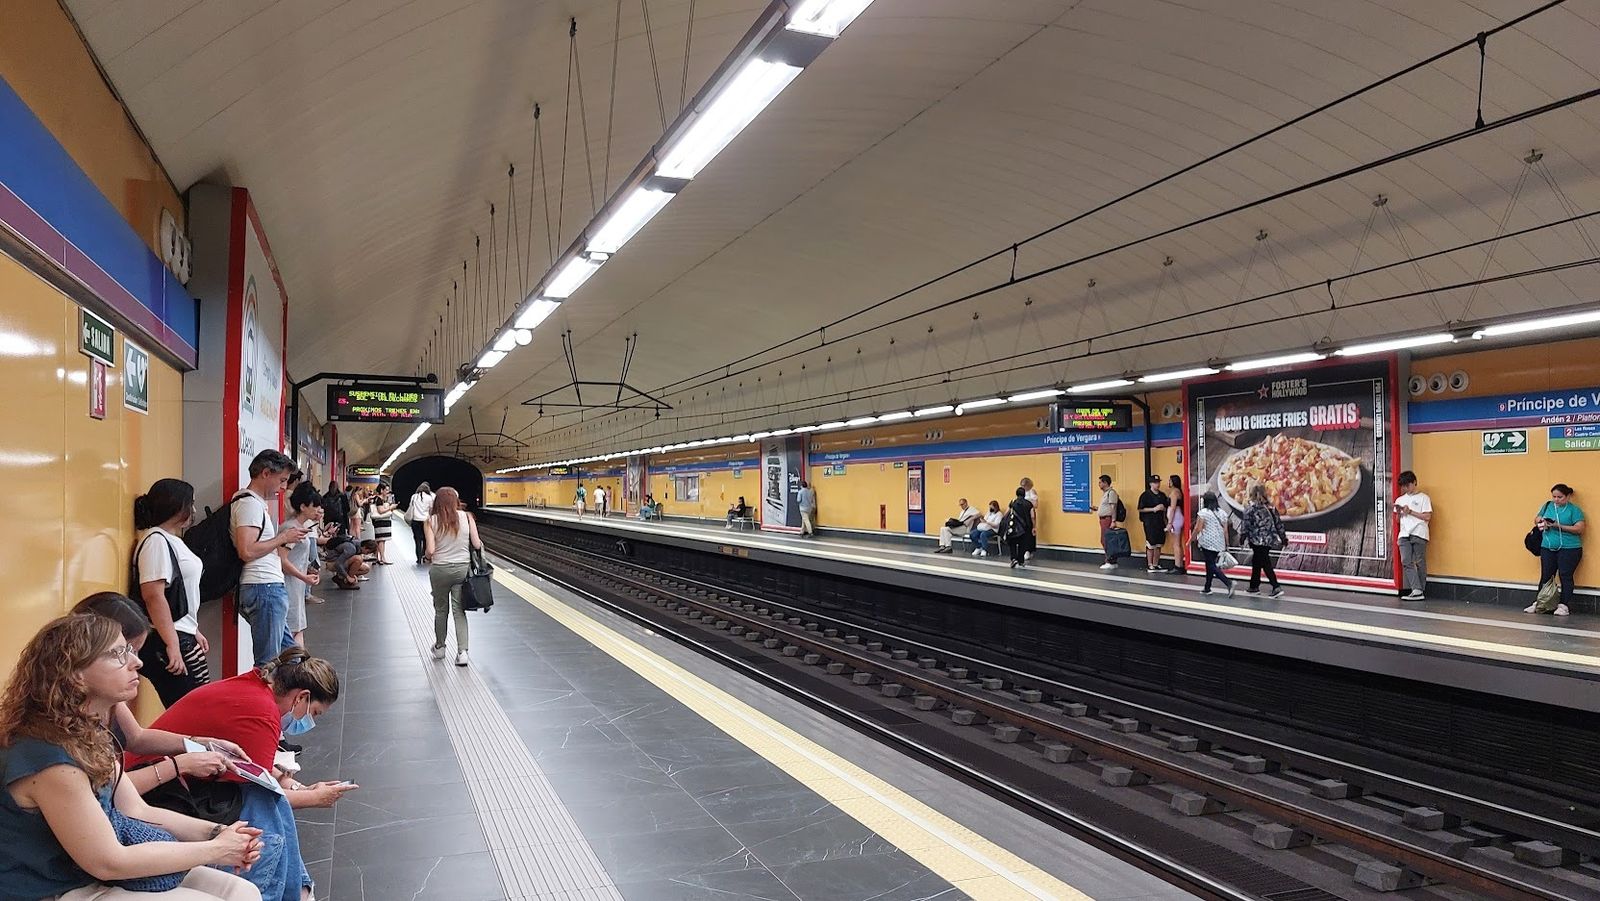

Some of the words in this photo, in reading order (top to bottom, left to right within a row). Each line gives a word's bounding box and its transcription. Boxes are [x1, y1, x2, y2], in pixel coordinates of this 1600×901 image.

[1271, 378, 1308, 390] FOSTER'S
[1271, 387, 1308, 399] HOLLYWOOD
[1507, 396, 1564, 412] Príncipe
[1569, 394, 1588, 408] de
[1215, 415, 1242, 432] BACON
[1242, 415, 1250, 431] &
[1250, 413, 1282, 430] CHEESE
[1282, 411, 1308, 428] FRIES
[1309, 402, 1358, 428] GRATIS
[1540, 415, 1565, 424] Andén
[1565, 415, 1571, 423] 2
[1566, 428, 1572, 436] 2
[1565, 439, 1591, 448] Salida
